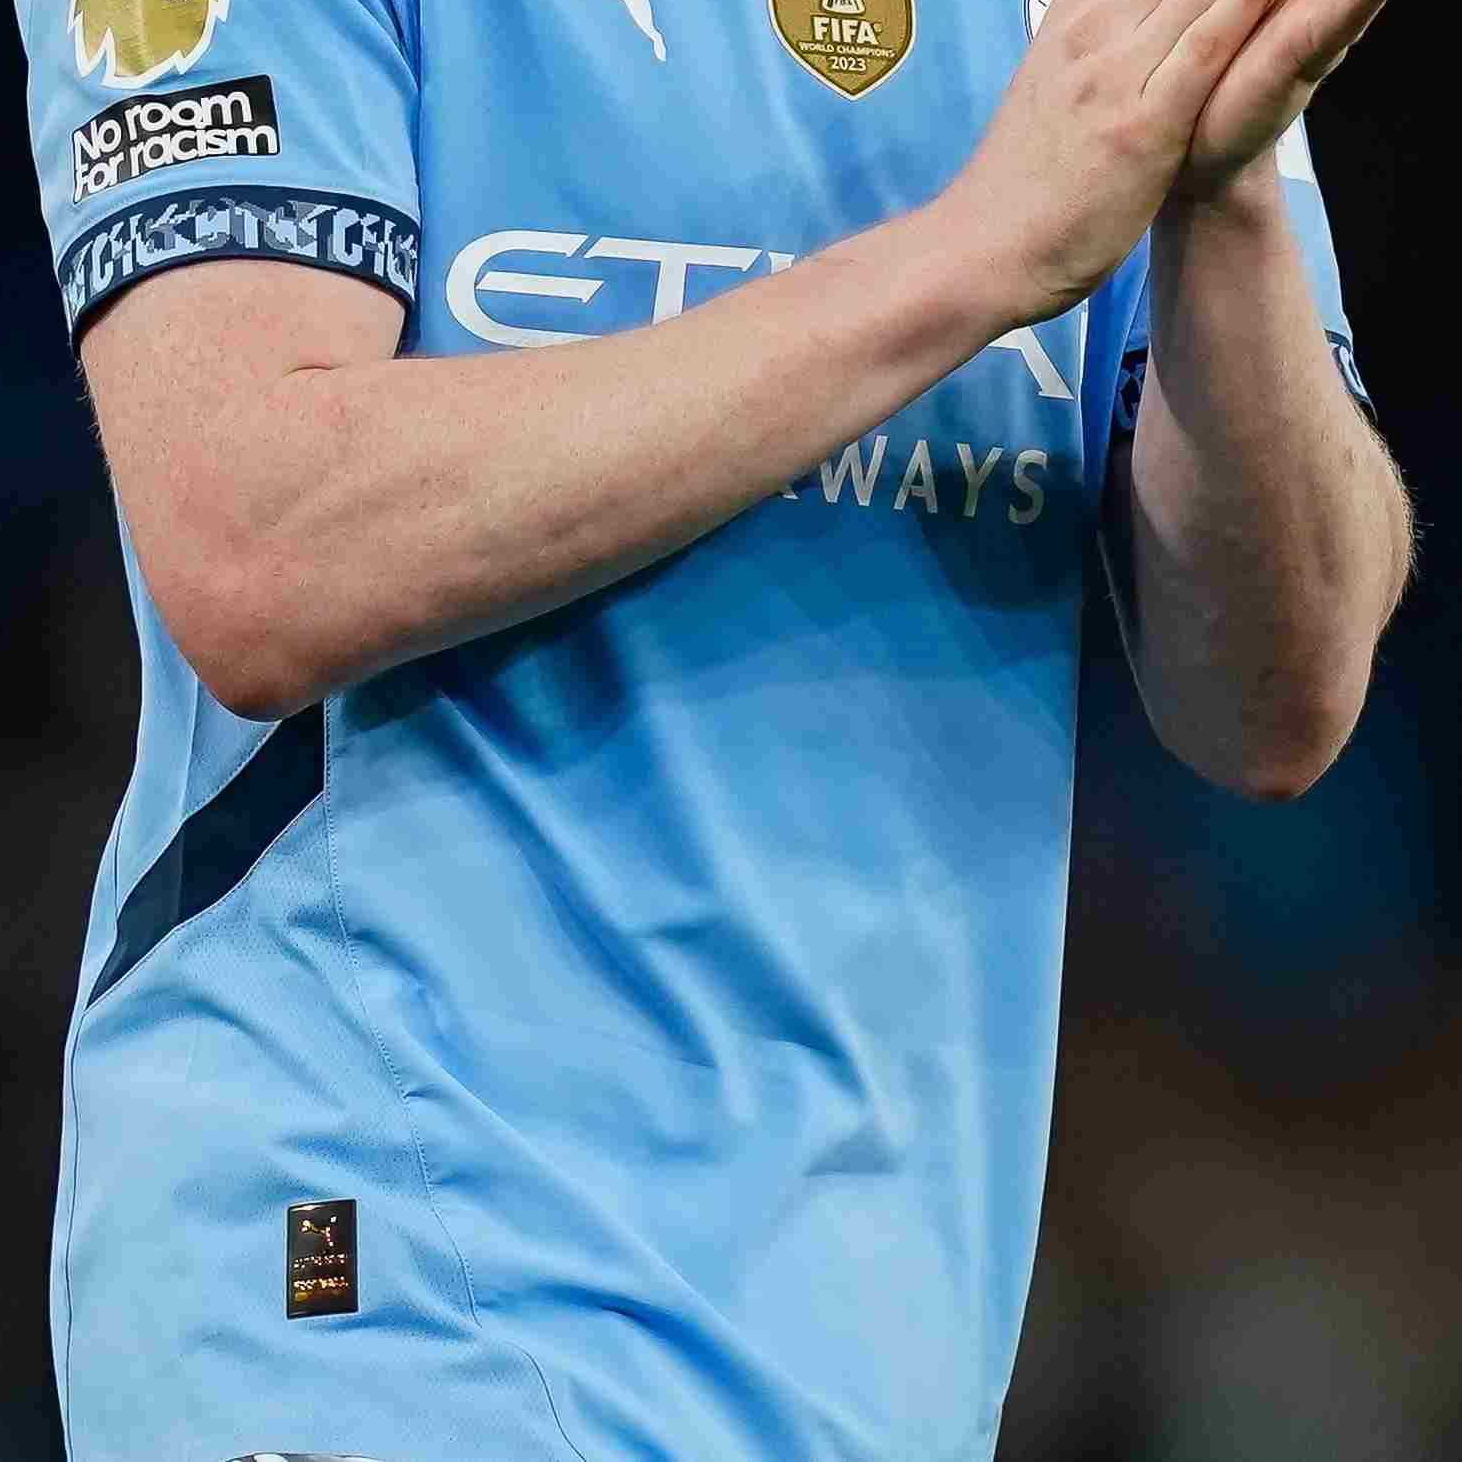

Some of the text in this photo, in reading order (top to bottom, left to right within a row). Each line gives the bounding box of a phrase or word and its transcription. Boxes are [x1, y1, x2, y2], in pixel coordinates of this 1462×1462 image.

[798, 41, 895, 58] WORLD CHAMPIONS
[813, 16, 878, 45] FIFA
[828, 56, 867, 71] 2023
[73, 91, 252, 167] No room
[129, 125, 278, 177] racism
[781, 434, 1051, 526] WAYS
